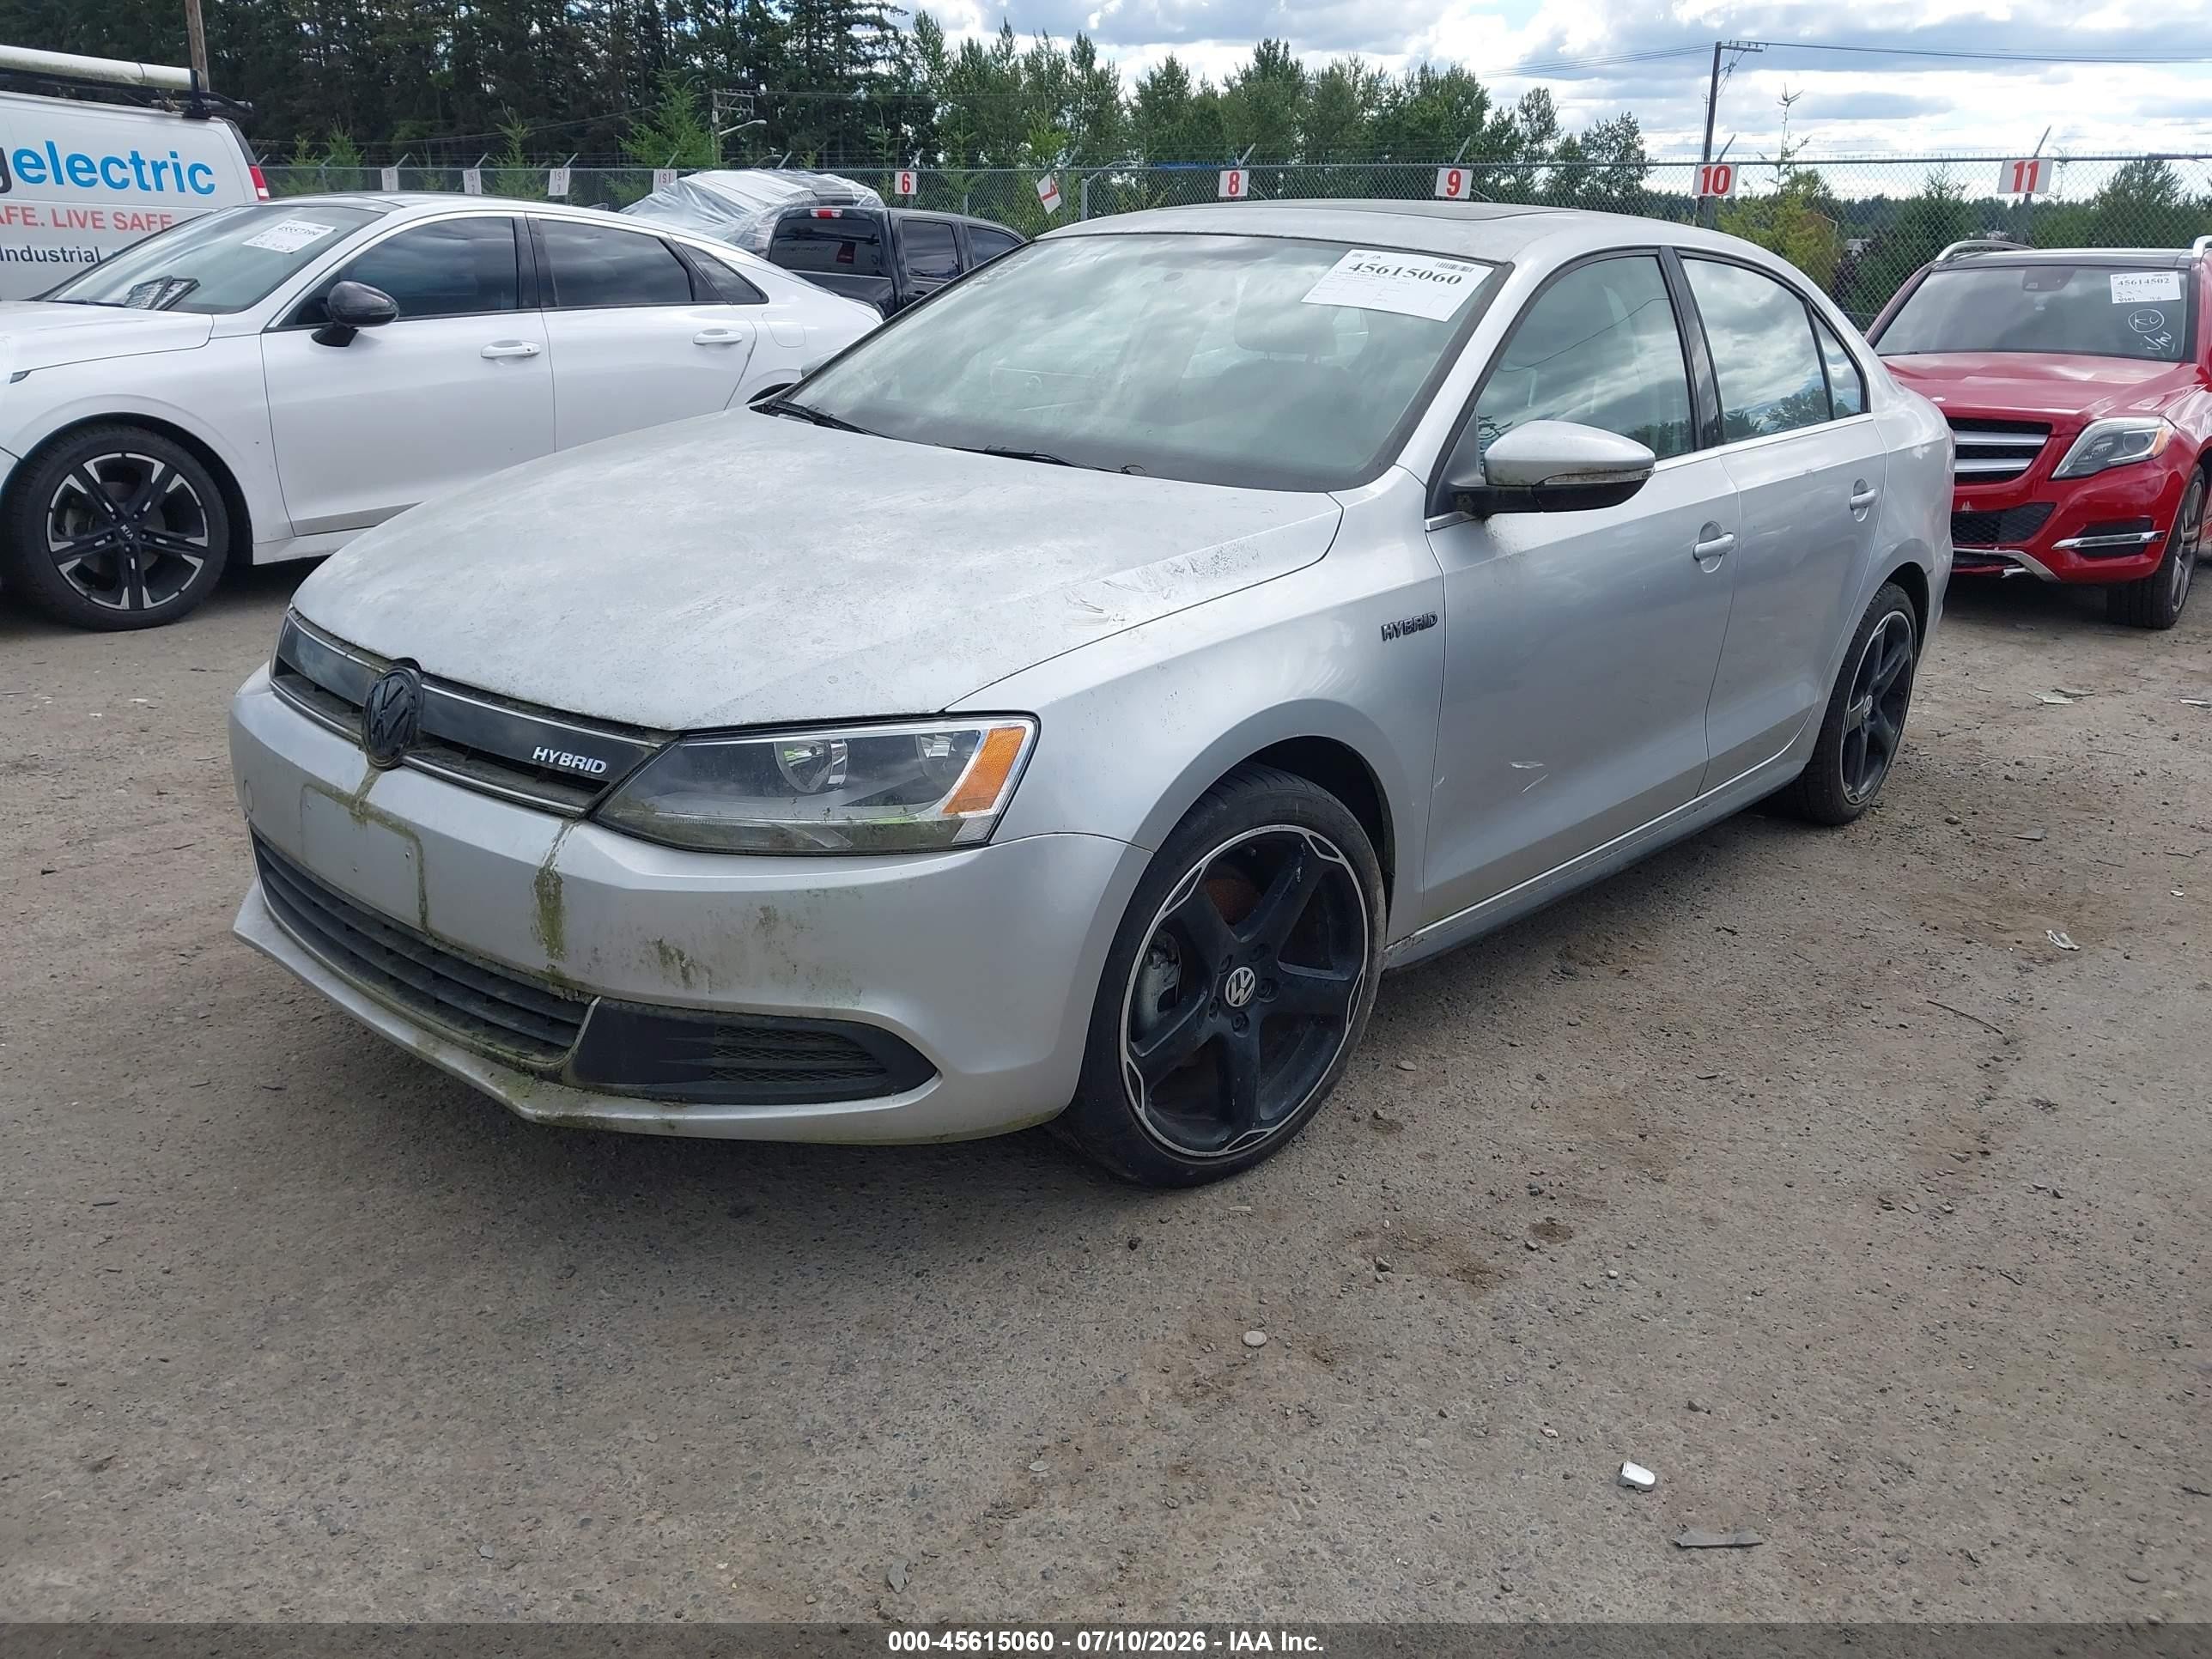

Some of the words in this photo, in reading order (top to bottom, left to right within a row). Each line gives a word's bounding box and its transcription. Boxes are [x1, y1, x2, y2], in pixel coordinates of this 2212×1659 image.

[902, 173, 911, 193] 6
[1228, 171, 1240, 196] 8
[1446, 170, 1462, 197] 9
[1702, 165, 1731, 195] 10
[2014, 161, 2039, 192] 11
[51, 208, 106, 230] LIVE
[1348, 261, 1463, 285] 45615060
[2118, 277, 2171, 286] 45614502
[120, 524, 134, 540] KIA
[1380, 611, 1438, 642] HYBRID
[532, 746, 607, 775] HYBRID
